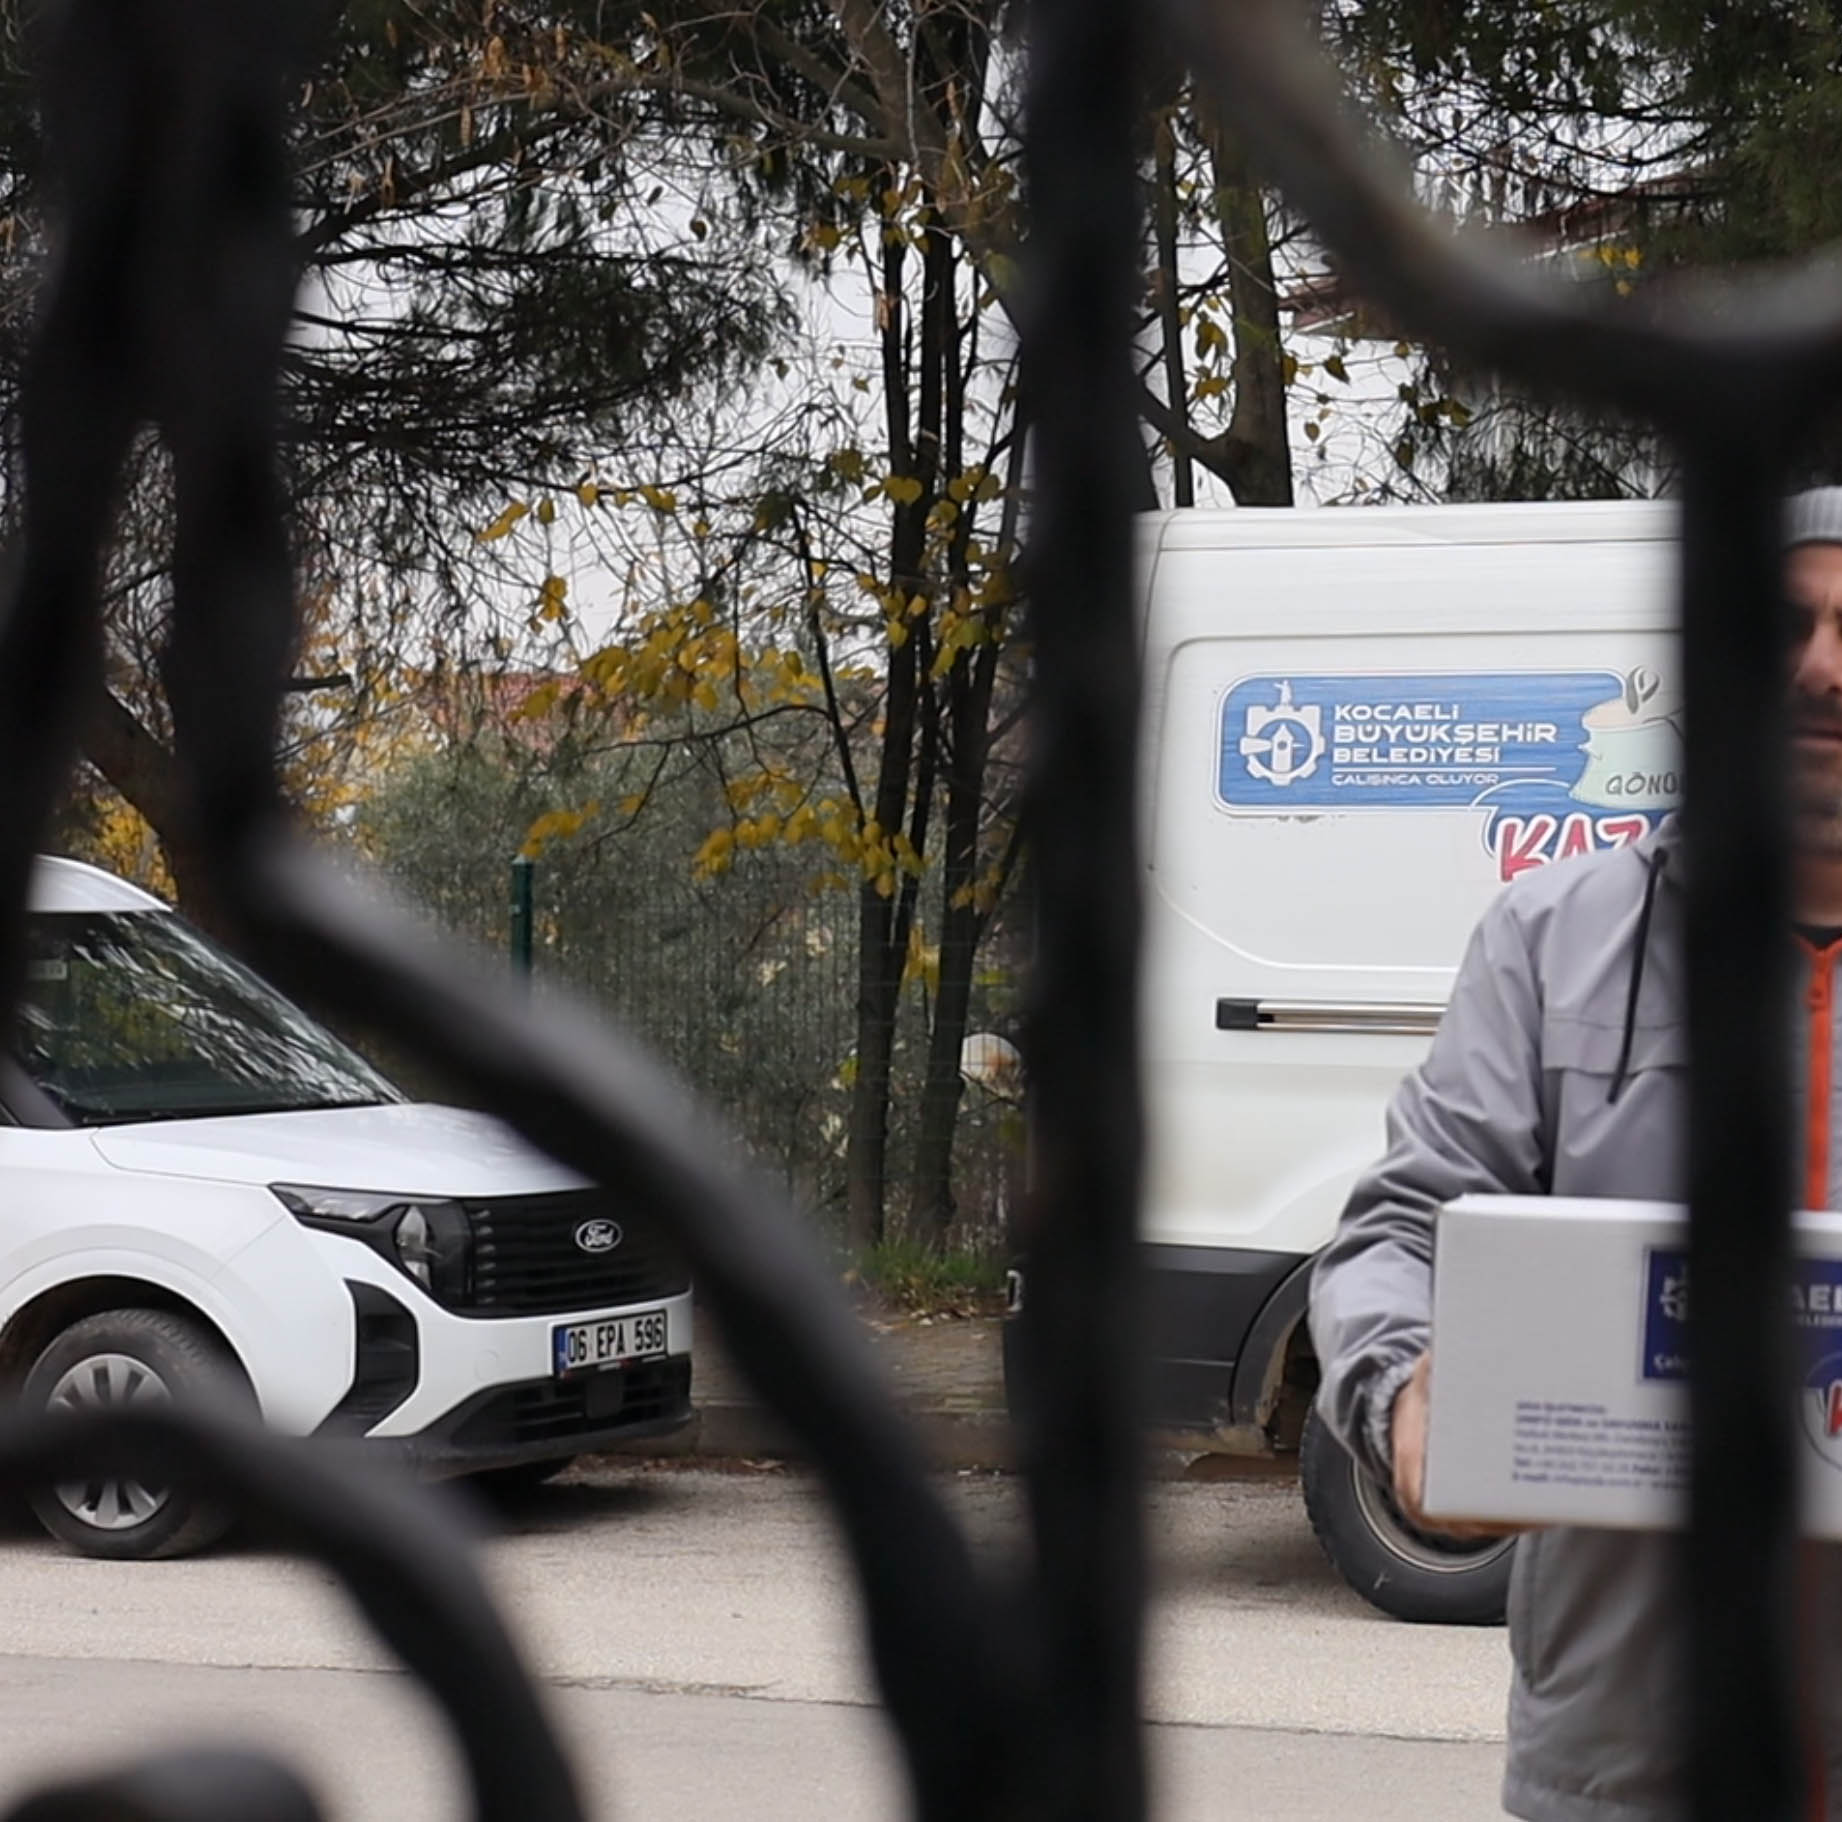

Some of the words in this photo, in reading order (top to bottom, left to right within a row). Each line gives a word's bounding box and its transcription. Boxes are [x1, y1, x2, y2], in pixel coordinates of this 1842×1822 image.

[1334, 704, 1459, 721] KOCAELİ
[1333, 723, 1558, 746] BÜYÜKŞEHİR
[1332, 746, 1500, 764] BELEDİYESİ
[1425, 773, 1499, 786] OLUYOR
[1605, 771, 1678, 795] GÖNÜ
[583, 1223, 615, 1247] Ford
[567, 1329, 587, 1364] 06
[596, 1322, 626, 1359] EPA
[634, 1317, 663, 1352] 596
